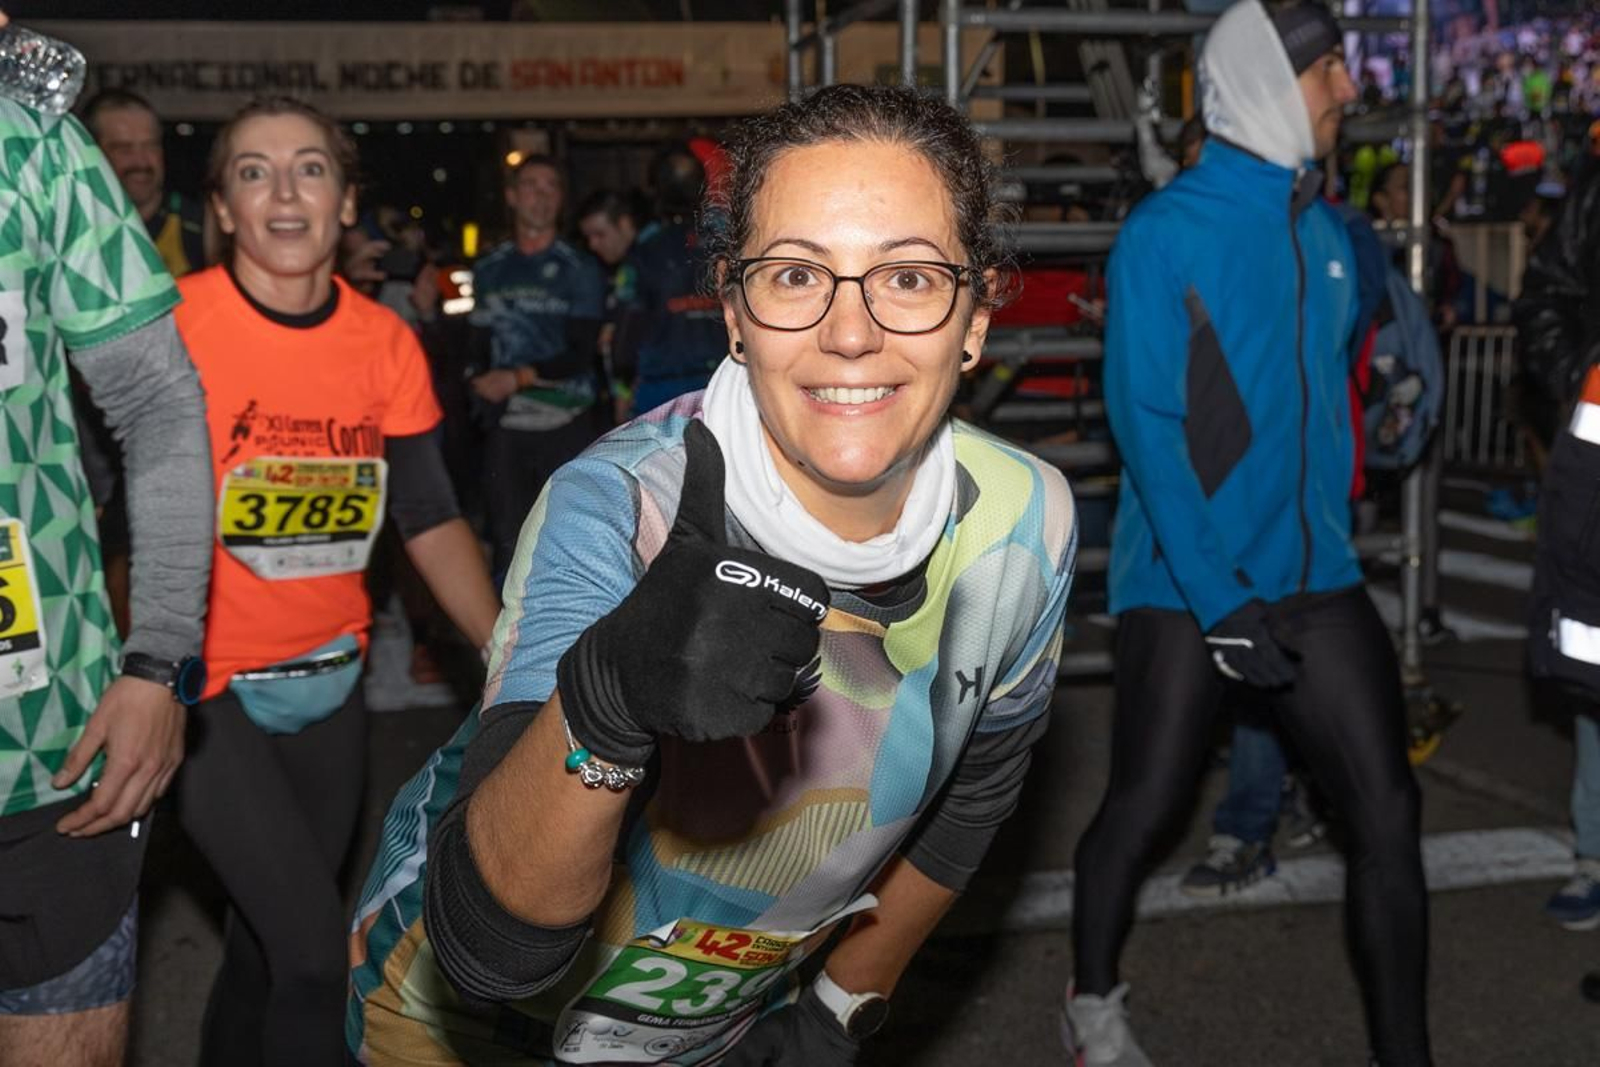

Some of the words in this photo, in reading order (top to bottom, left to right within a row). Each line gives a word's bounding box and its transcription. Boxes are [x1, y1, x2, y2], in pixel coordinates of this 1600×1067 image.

[340, 61, 447, 92] NOCHE
[459, 61, 500, 92] DE
[265, 465, 295, 485] 42
[233, 493, 369, 533] 3785
[694, 928, 753, 962] 42
[636, 1013, 671, 1027] GEMA
